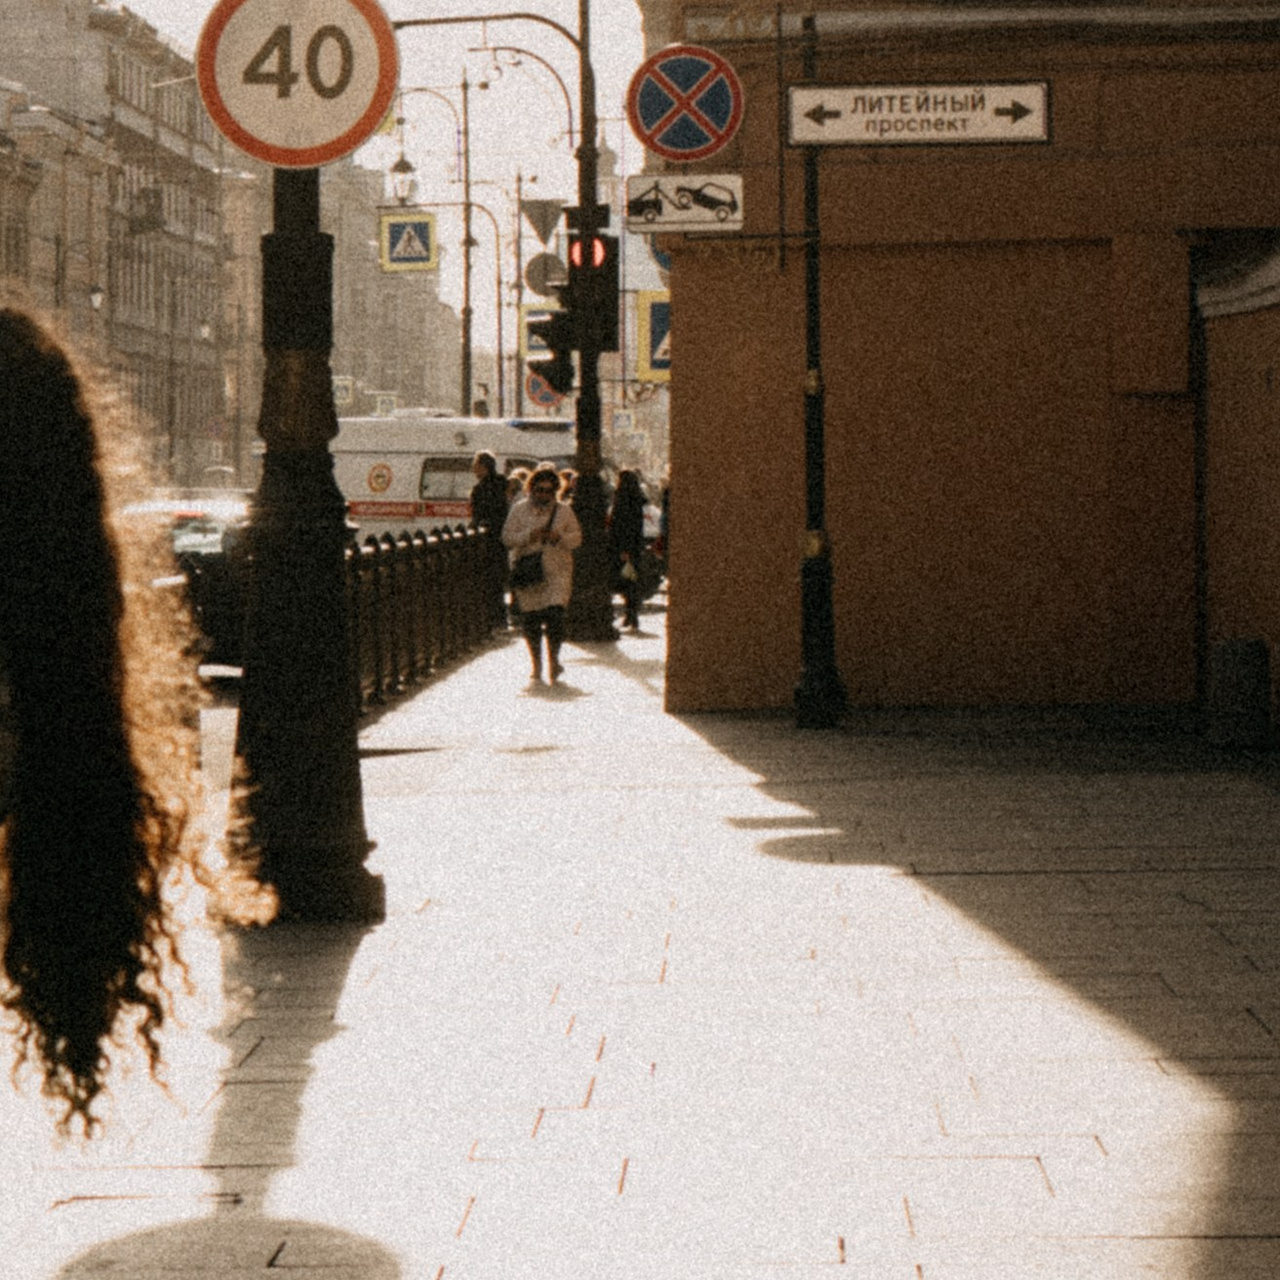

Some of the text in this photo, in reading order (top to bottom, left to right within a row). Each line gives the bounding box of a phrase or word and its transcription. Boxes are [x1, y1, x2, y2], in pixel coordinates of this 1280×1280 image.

[242, 24, 354, 100] 40
[850, 88, 987, 114] ЛИТЕЙНЫЙ
[864, 116, 971, 136] проспект
